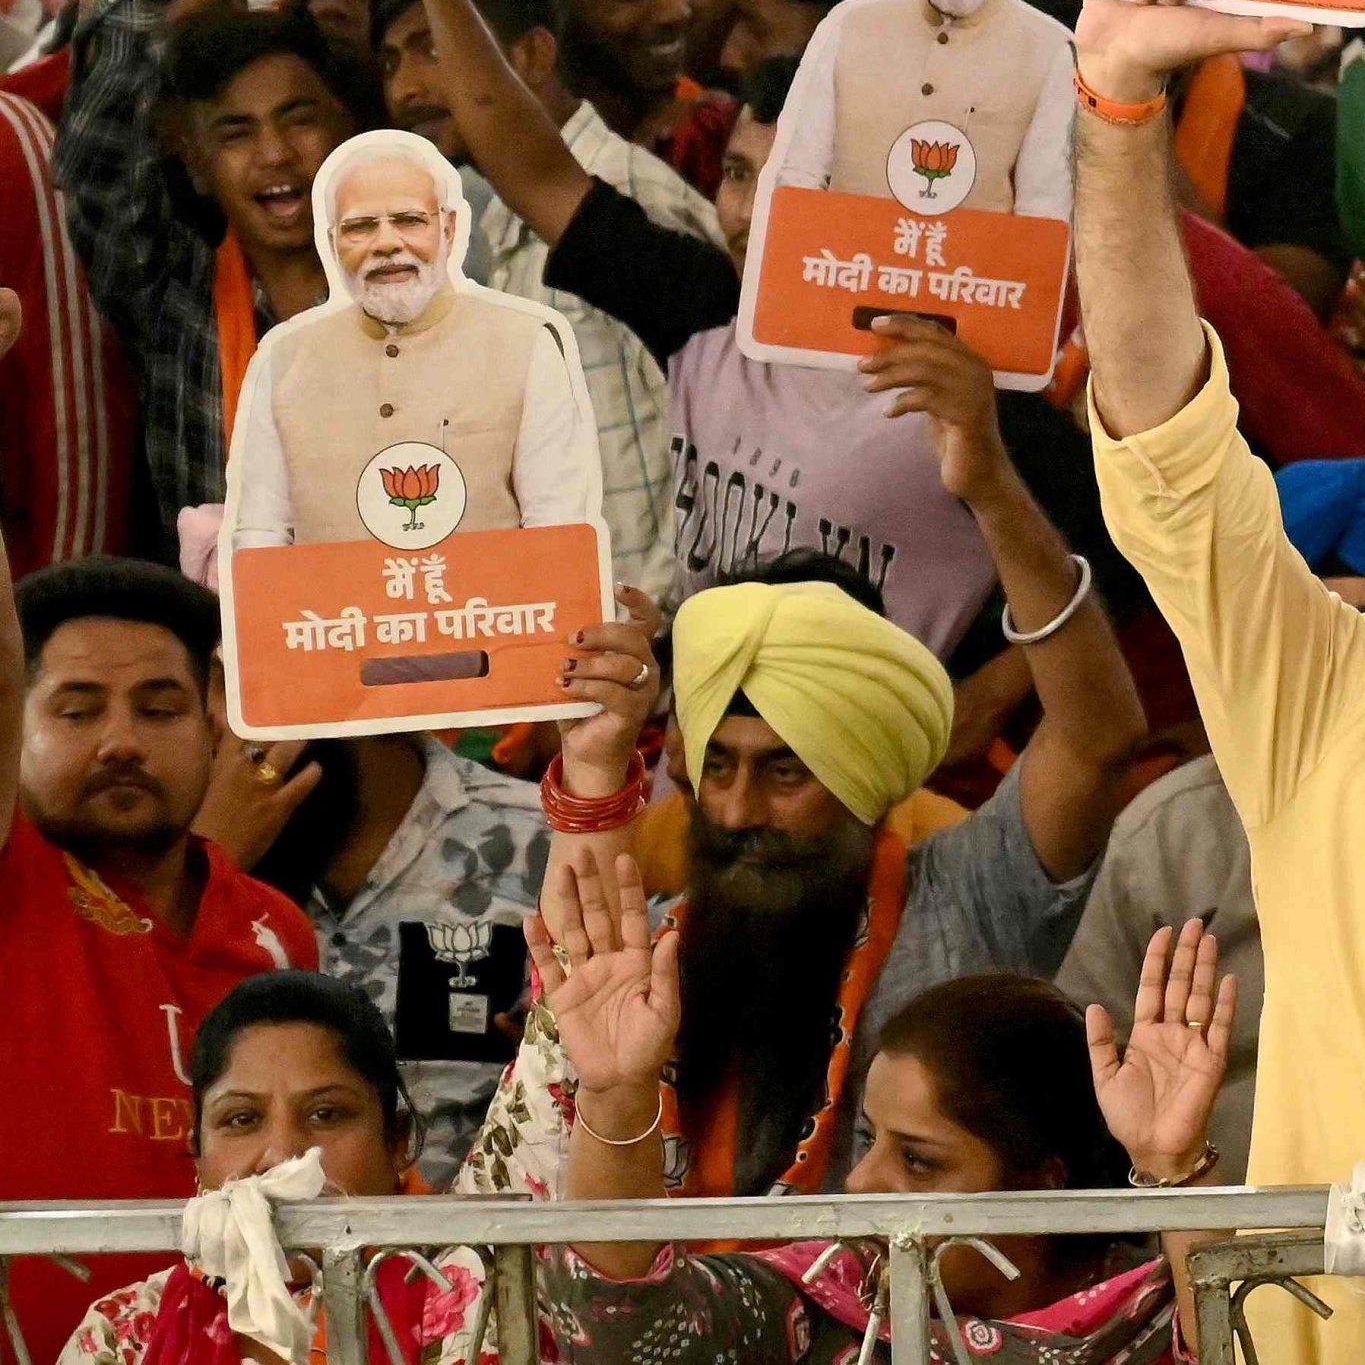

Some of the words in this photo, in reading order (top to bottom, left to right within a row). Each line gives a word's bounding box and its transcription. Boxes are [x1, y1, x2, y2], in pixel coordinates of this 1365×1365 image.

[894, 218, 925, 258] मैं
[925, 221, 948, 267] हूँ
[802, 249, 872, 293] मोदी
[877, 265, 922, 297] का
[927, 265, 1027, 309] परिवार
[382, 557, 420, 599] मैं
[421, 553, 453, 605] हूँ
[282, 607, 368, 652] मोदी
[373, 612, 428, 645] का
[434, 597, 557, 641] परिवार
